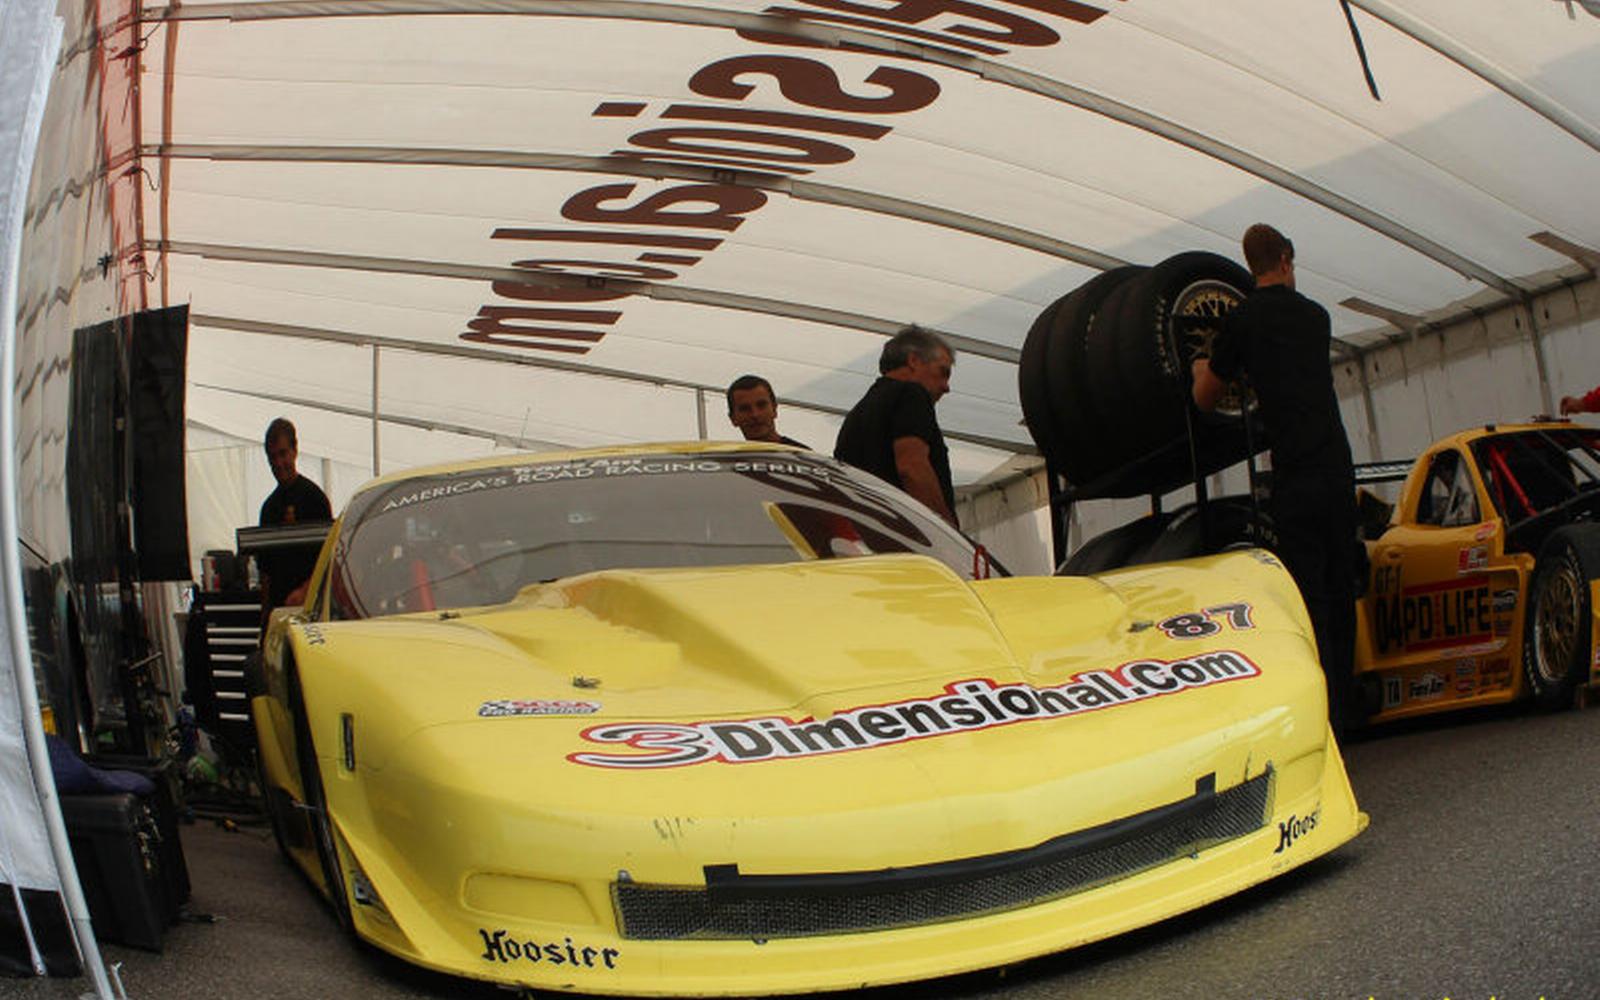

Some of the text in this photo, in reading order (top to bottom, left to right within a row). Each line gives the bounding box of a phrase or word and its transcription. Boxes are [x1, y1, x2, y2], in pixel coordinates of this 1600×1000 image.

[383, 461, 830, 512] AMERICA'S ROAD RACING SERIES
[1157, 602, 1256, 640] 87
[1443, 588, 1491, 636] LIFE
[479, 927, 620, 969] Hoosier
